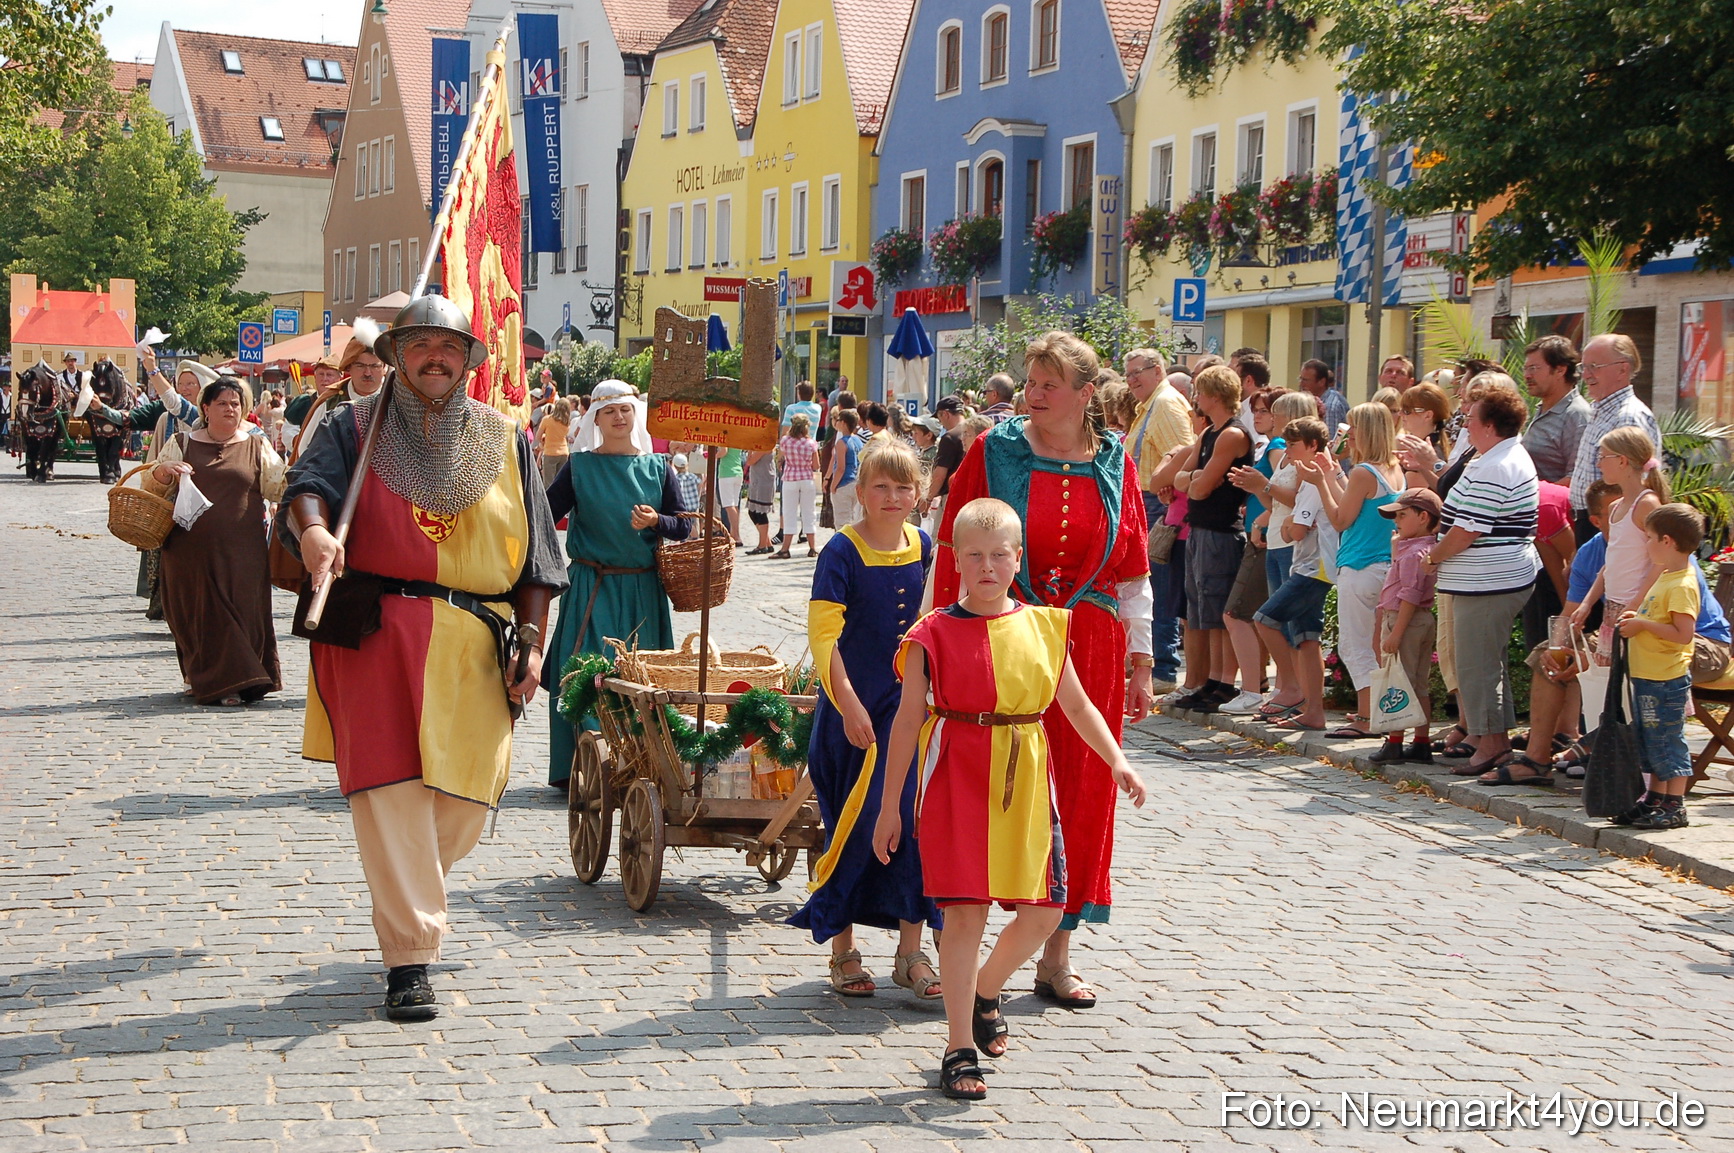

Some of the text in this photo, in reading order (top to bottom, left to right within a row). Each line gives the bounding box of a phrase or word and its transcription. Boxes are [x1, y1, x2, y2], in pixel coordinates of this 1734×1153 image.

[543, 102, 561, 220] K&L RUPPERT
[676, 161, 746, 194] HOTEL Lehmeier
[1101, 198, 1117, 285] WITTL
[1454, 215, 1467, 296] KIO
[706, 284, 744, 295] WISSMAC
[1179, 283, 1199, 317] P
[240, 349, 261, 360] TAXI
[908, 402, 916, 415] P
[682, 426, 728, 444] Neumarkt
